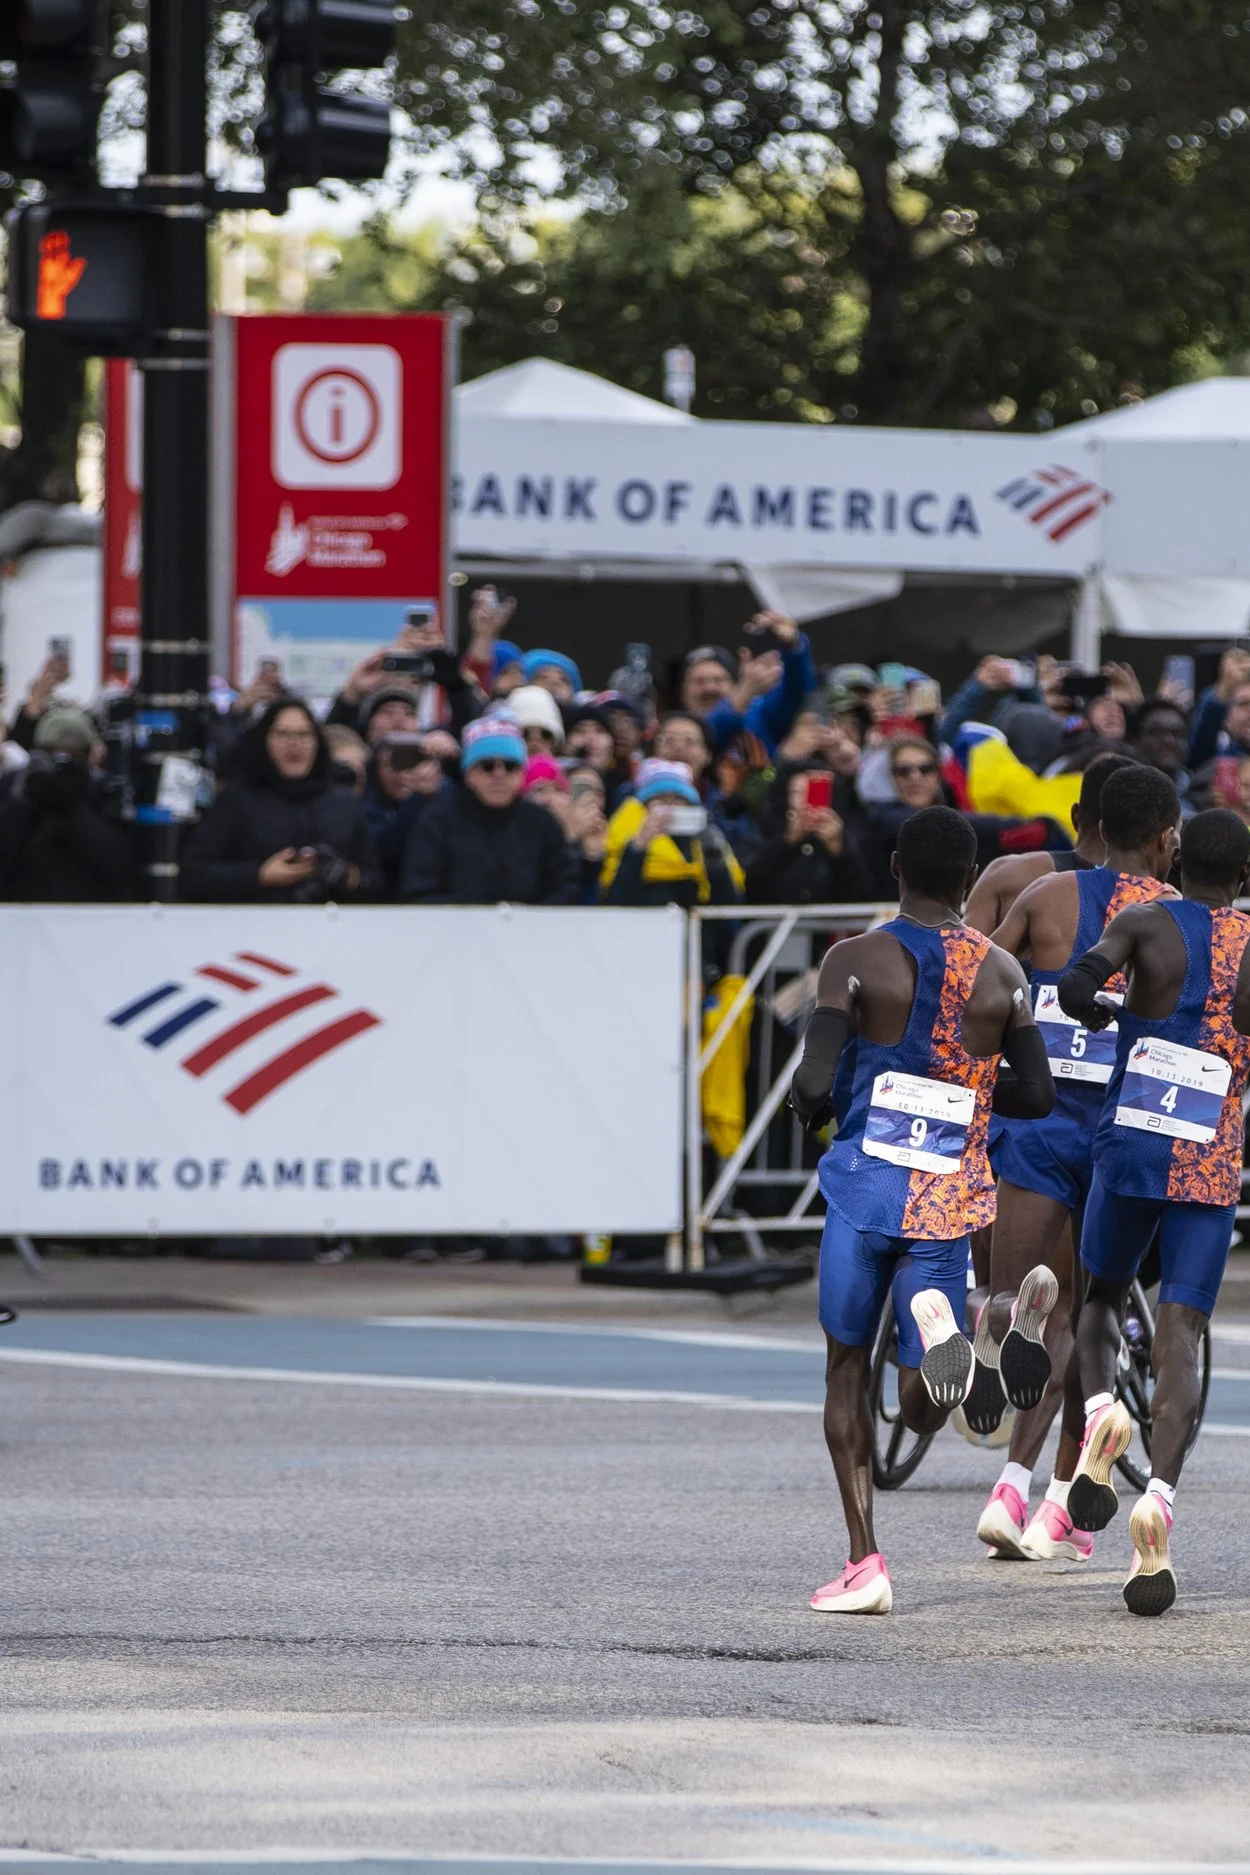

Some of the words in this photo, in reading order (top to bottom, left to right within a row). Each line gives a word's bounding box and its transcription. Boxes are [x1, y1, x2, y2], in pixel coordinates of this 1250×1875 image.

[614, 477, 693, 526] OF
[705, 481, 982, 538] AMERICA
[1070, 1029, 1088, 1058] 5
[1150, 1049, 1173, 1060] Chicago
[1149, 1055, 1177, 1067] Marathon
[1160, 1085, 1179, 1113] 4
[908, 1118, 927, 1147] 9
[38, 1157, 162, 1191] BANK
[173, 1157, 229, 1191] OF
[240, 1157, 443, 1191] AMERICA
